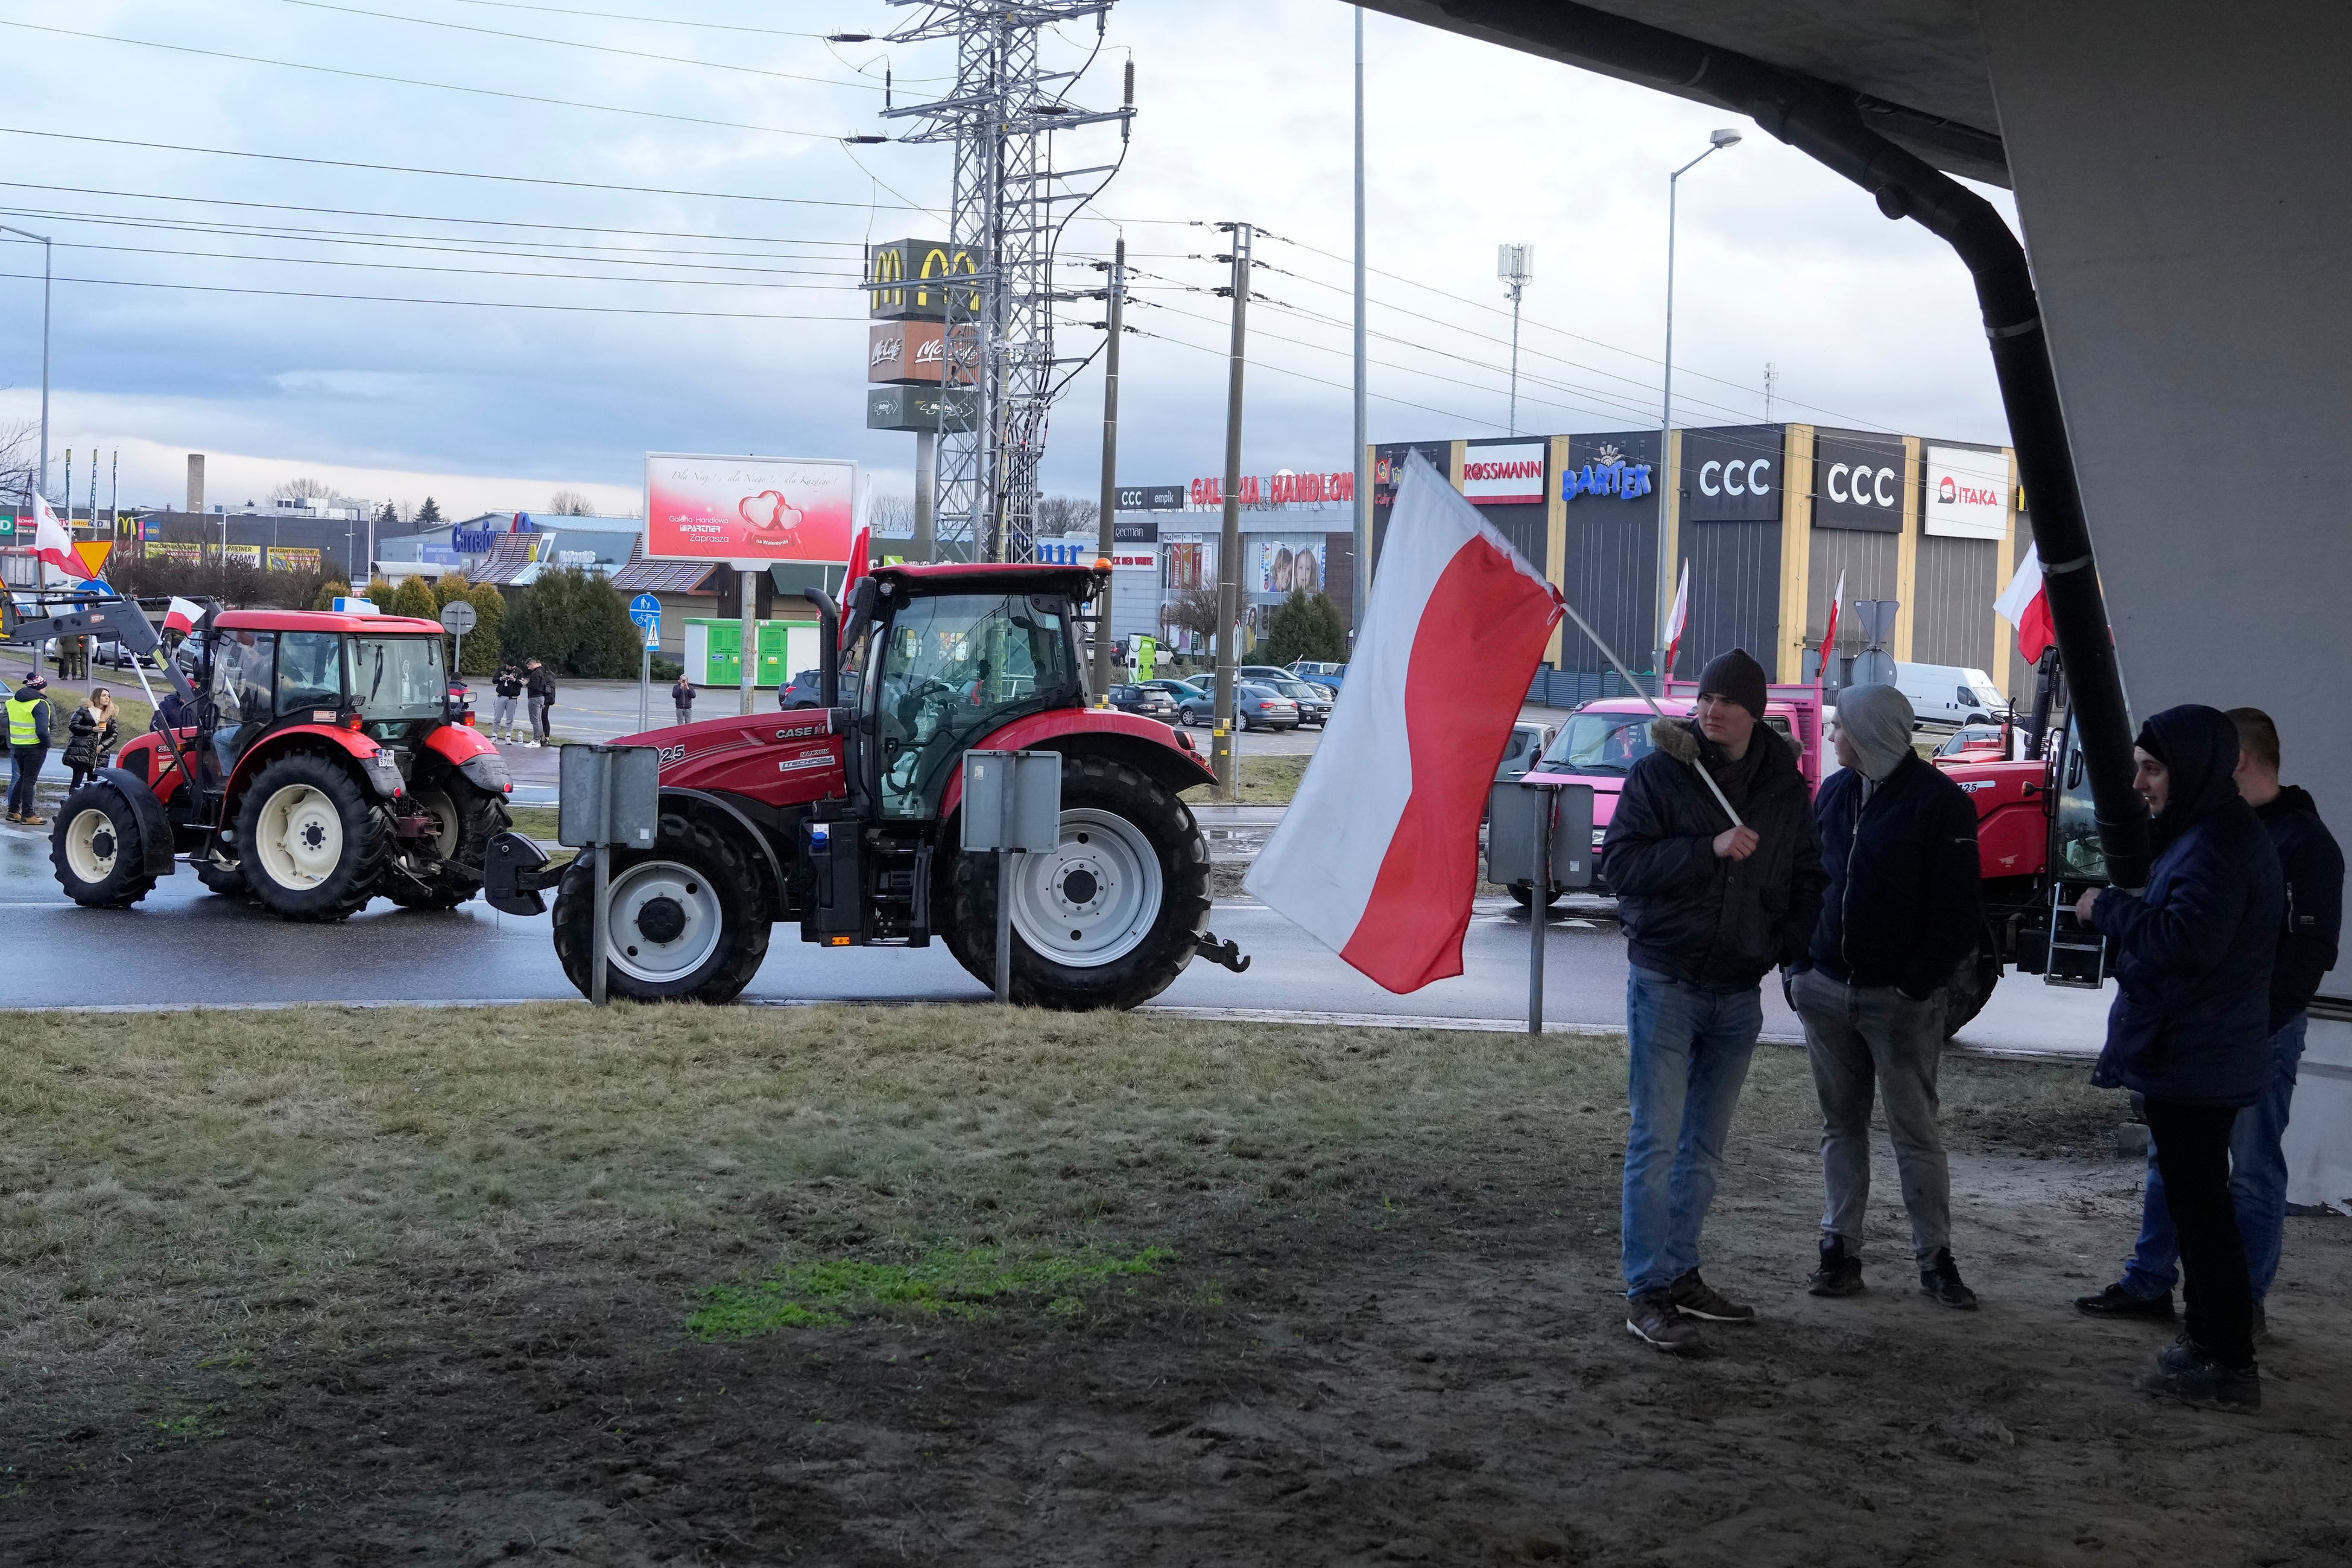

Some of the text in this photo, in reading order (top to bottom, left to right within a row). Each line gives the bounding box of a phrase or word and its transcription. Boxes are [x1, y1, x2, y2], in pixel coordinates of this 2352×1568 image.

[1464, 461, 1541, 480] ROSSMANN
[1699, 458, 1771, 496] CCC
[1192, 472, 1353, 504] GALRIA HANDLOW
[1562, 460, 1651, 501] BARTEK
[1827, 463, 1895, 507] CCC
[1122, 491, 1142, 505] CCC
[1154, 490, 1174, 508] empik
[1959, 486, 1997, 507] ITAKA
[690, 534, 729, 543] Zaprasza
[776, 727, 812, 740] CASE
[659, 744, 685, 763] 25
[800, 748, 830, 757] MAXXUM
